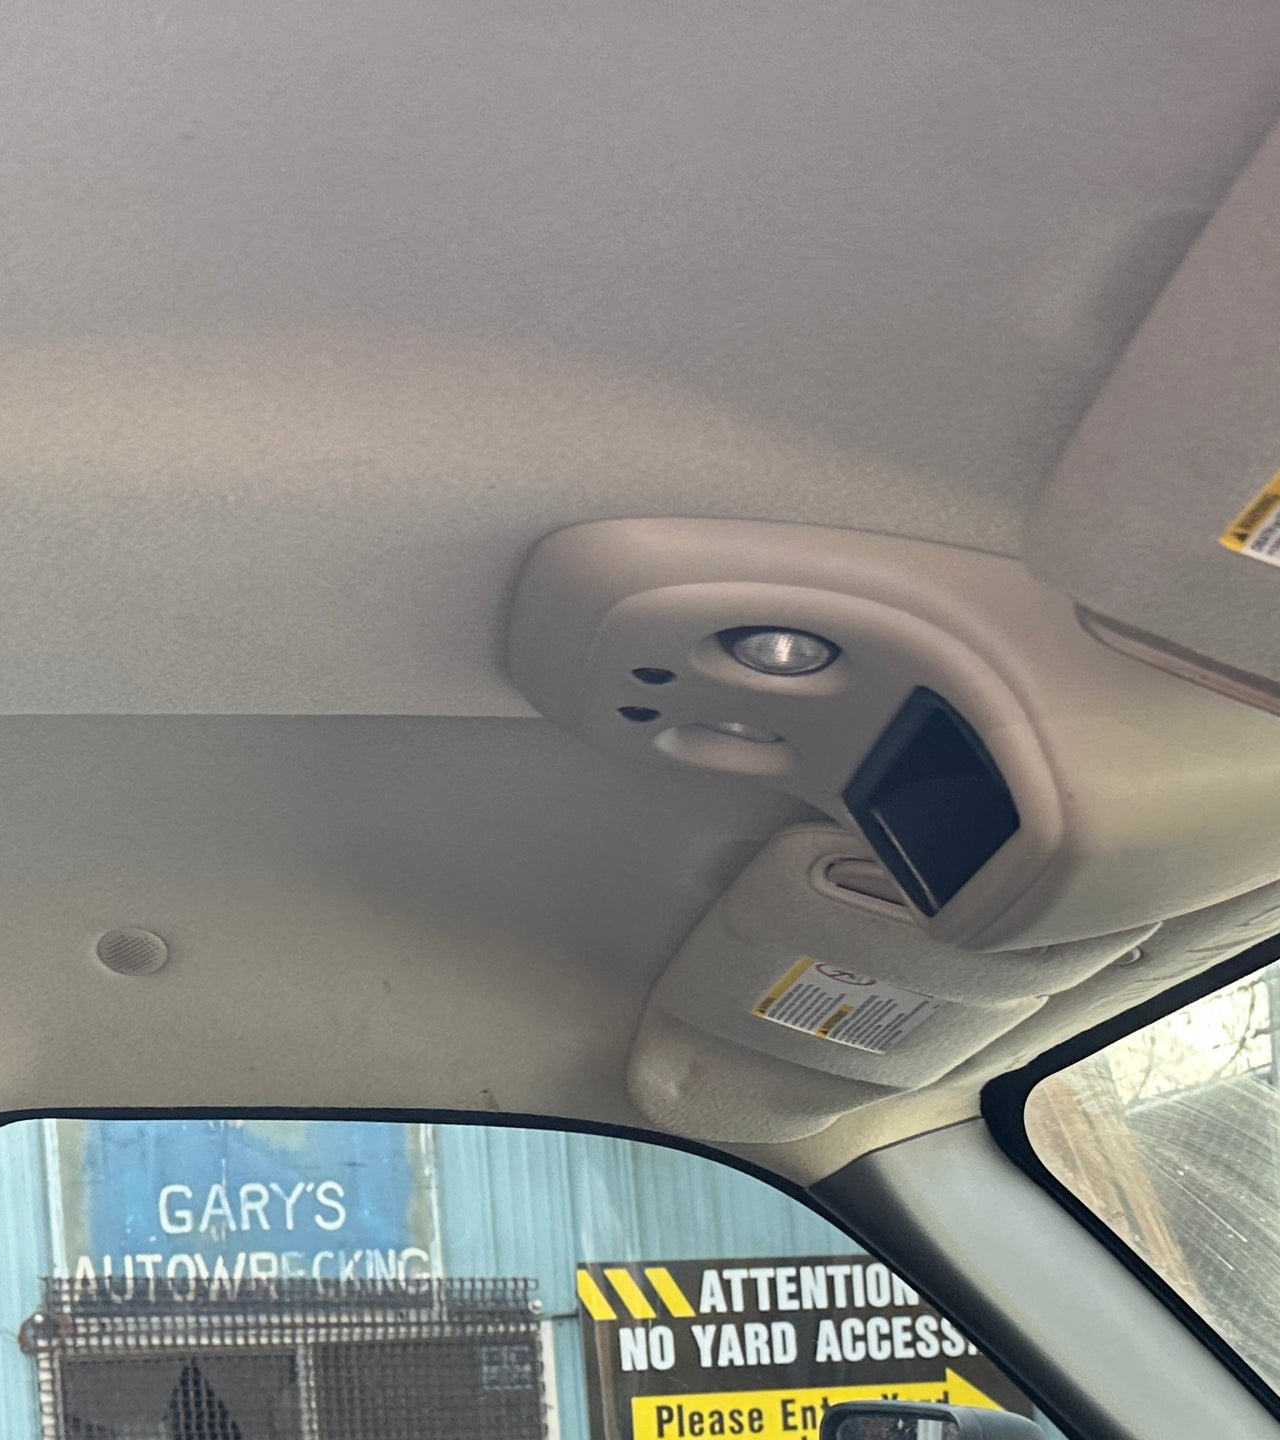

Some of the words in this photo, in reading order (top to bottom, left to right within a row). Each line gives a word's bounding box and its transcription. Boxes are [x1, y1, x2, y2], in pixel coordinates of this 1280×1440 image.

[158, 1180, 347, 1235] GARY'S
[620, 1327, 675, 1371] NO
[694, 1322, 797, 1368] YARD
[656, 1405, 764, 1438] Please
